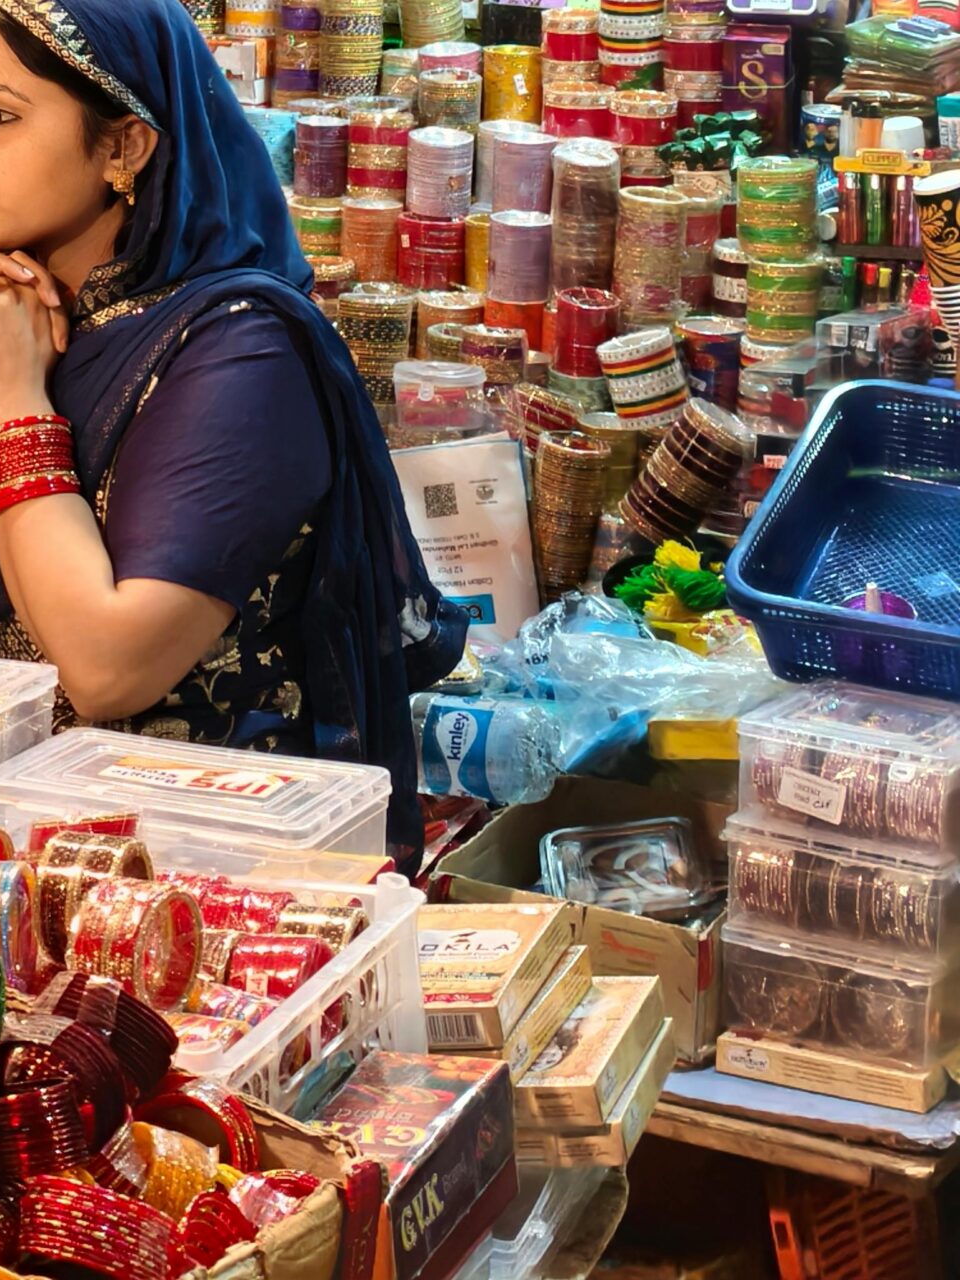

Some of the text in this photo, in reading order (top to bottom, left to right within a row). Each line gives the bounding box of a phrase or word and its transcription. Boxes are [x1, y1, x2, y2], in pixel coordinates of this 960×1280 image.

[453, 565, 464, 574] 12
[447, 712, 470, 761] kinley
[420, 943, 510, 952] OKILA
[400, 1172, 444, 1253] GVK
